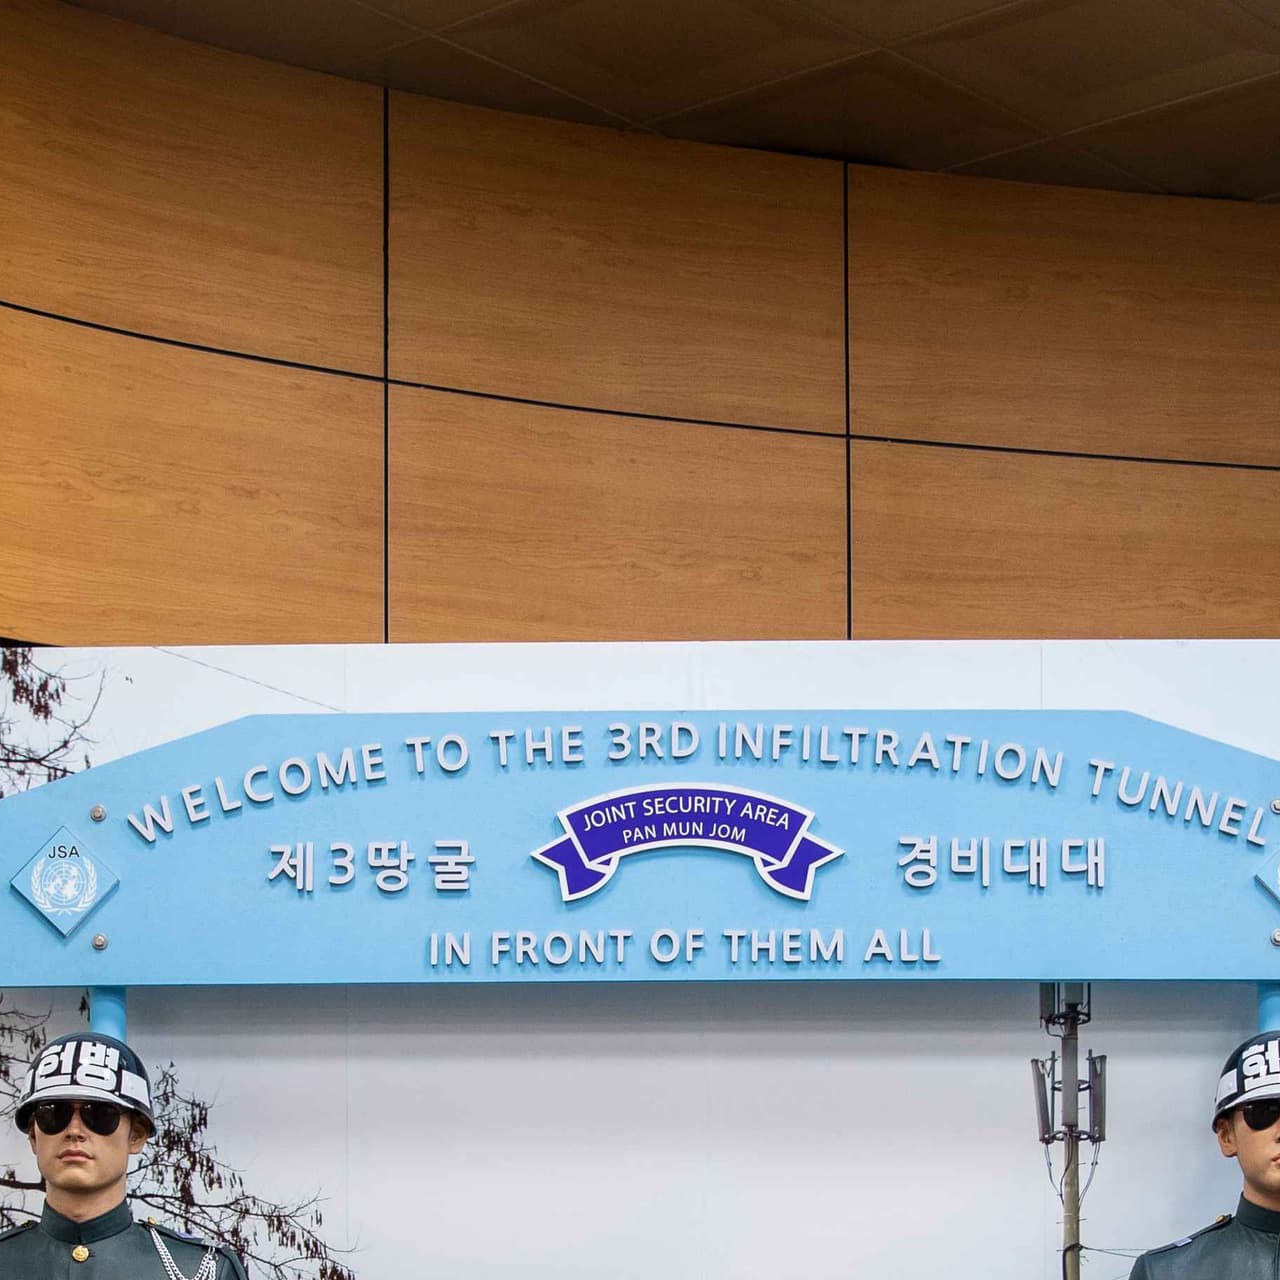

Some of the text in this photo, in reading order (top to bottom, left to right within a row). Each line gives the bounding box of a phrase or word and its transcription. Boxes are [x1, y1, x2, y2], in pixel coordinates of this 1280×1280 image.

[127, 721, 1269, 847] WELCOME TO THE 3RD INFILTRATION TUNNEL
[583, 796, 790, 831] JOINT SECURITY AREA
[622, 822, 747, 844] PAN MUN JOM
[47, 843, 81, 860] JSA
[897, 835, 1107, 889] 경비대대
[429, 928, 942, 967] IN FRONT OF THEM ALL
[34, 1040, 121, 1093] 헌병
